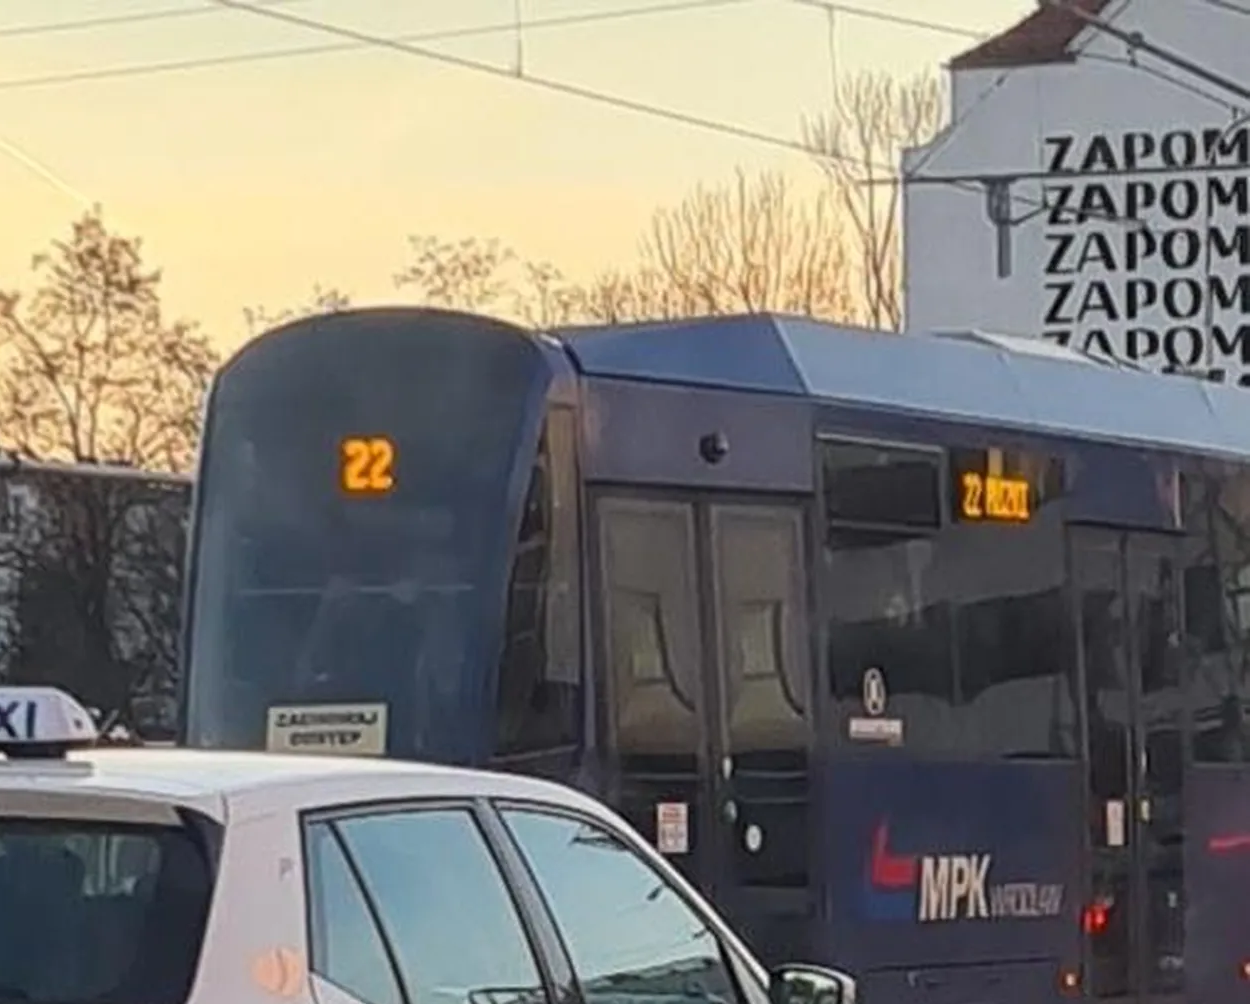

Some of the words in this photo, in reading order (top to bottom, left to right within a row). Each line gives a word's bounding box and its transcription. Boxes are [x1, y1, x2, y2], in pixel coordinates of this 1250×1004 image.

[1047, 177, 1250, 226] ZAPOM
[1045, 226, 1250, 274] ZAPOM
[1045, 275, 1250, 324] ZAPOM
[344, 438, 393, 490] 22
[918, 854, 992, 921] MPK
